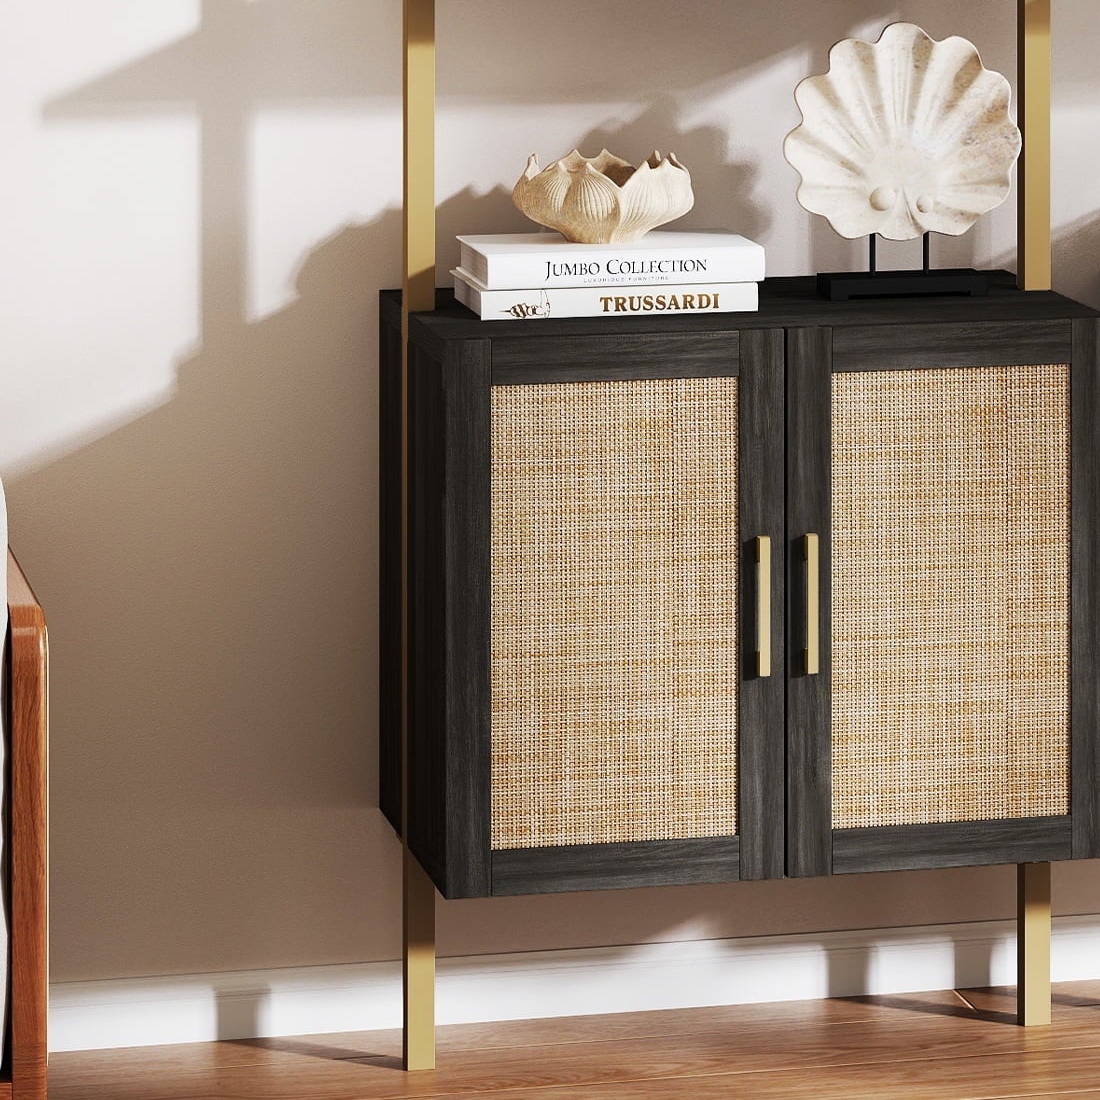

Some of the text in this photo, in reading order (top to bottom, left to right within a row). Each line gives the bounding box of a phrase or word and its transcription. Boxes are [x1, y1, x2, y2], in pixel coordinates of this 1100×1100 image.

[544, 259, 707, 281] JUMBO COLLECTION
[600, 293, 720, 312] TRUSSARDI
